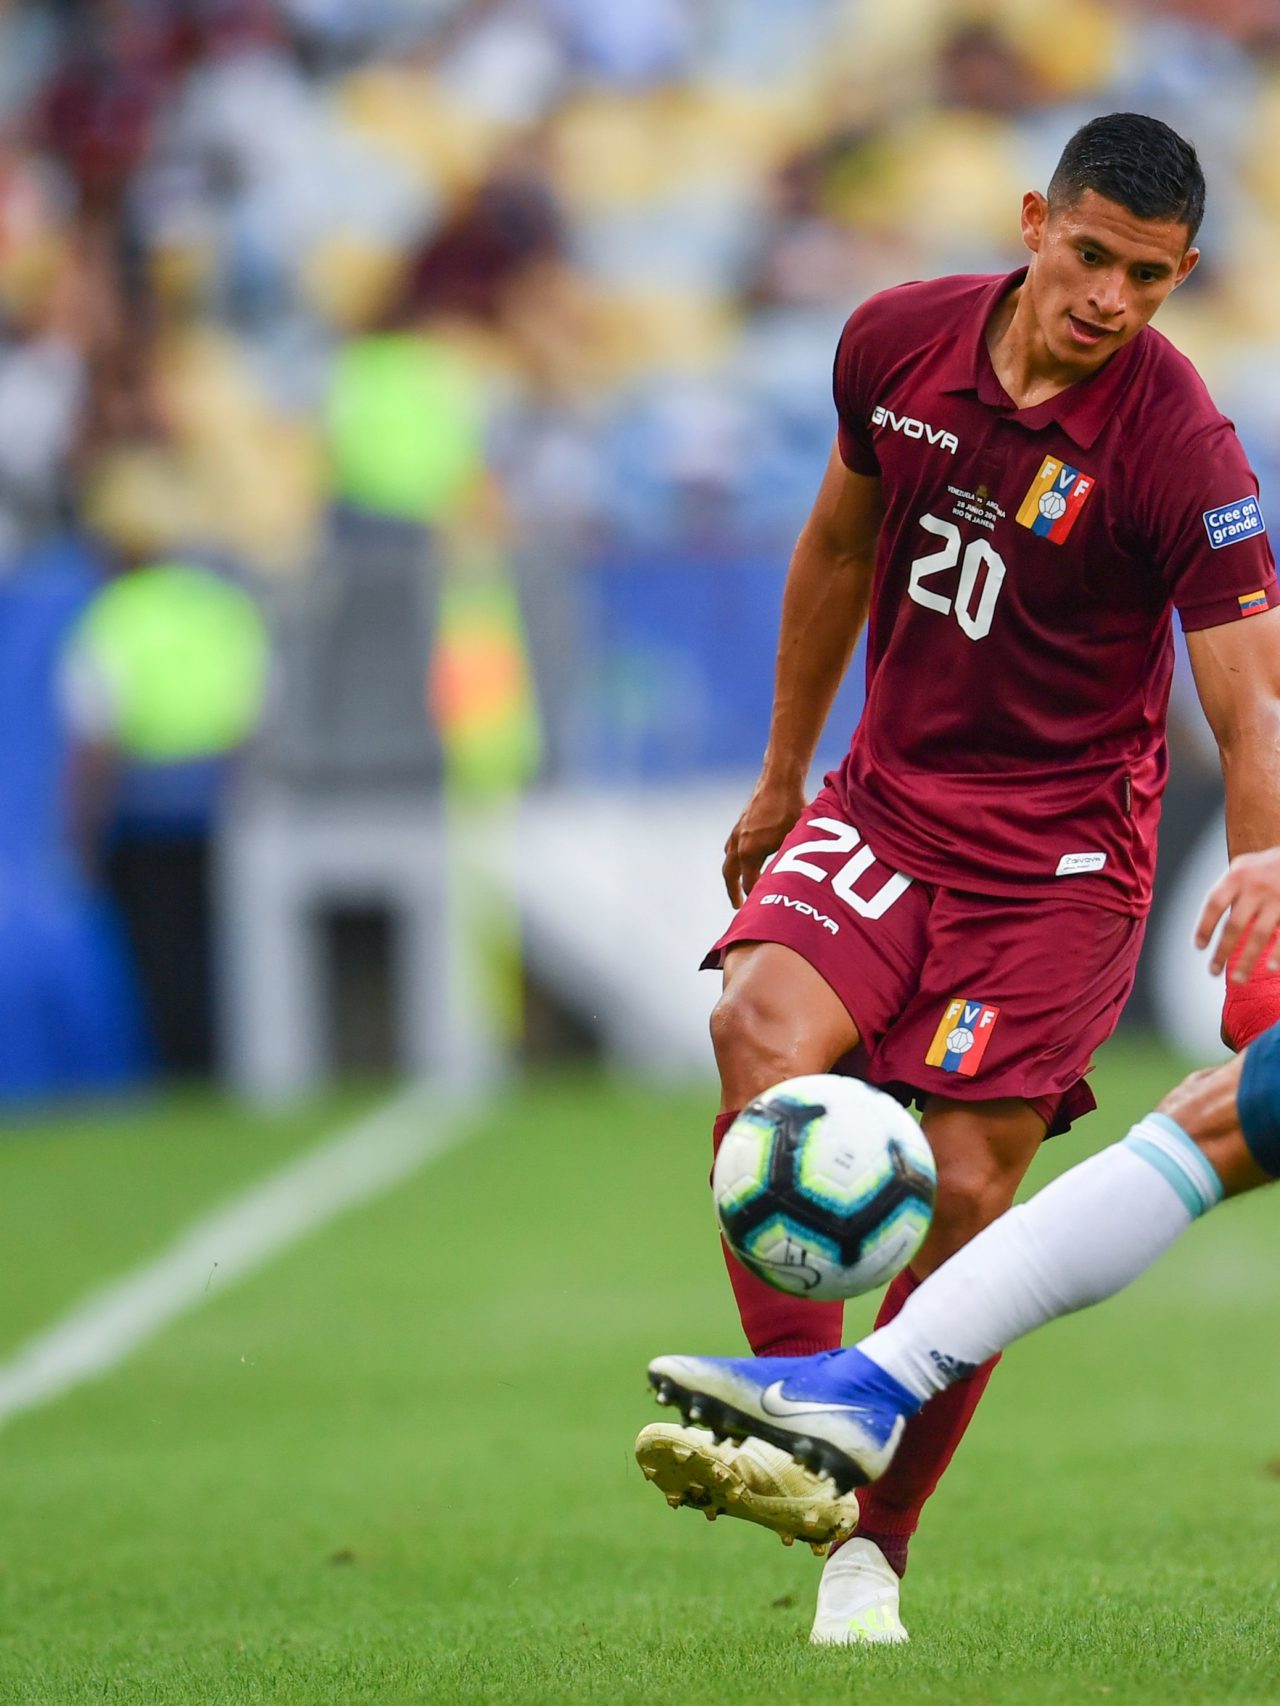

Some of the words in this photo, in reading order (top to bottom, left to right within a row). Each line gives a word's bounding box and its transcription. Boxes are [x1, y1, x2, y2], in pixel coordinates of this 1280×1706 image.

[871, 405, 959, 455] GIVOVA
[1041, 462, 1090, 497] FVF
[1209, 509, 1241, 527] Cree
[1242, 503, 1257, 517] en
[1213, 516, 1259, 544] grande
[907, 512, 1007, 641] 20
[771, 816, 914, 920] 20
[760, 894, 840, 935] GIVOVA
[946, 1003, 995, 1028] FVF
